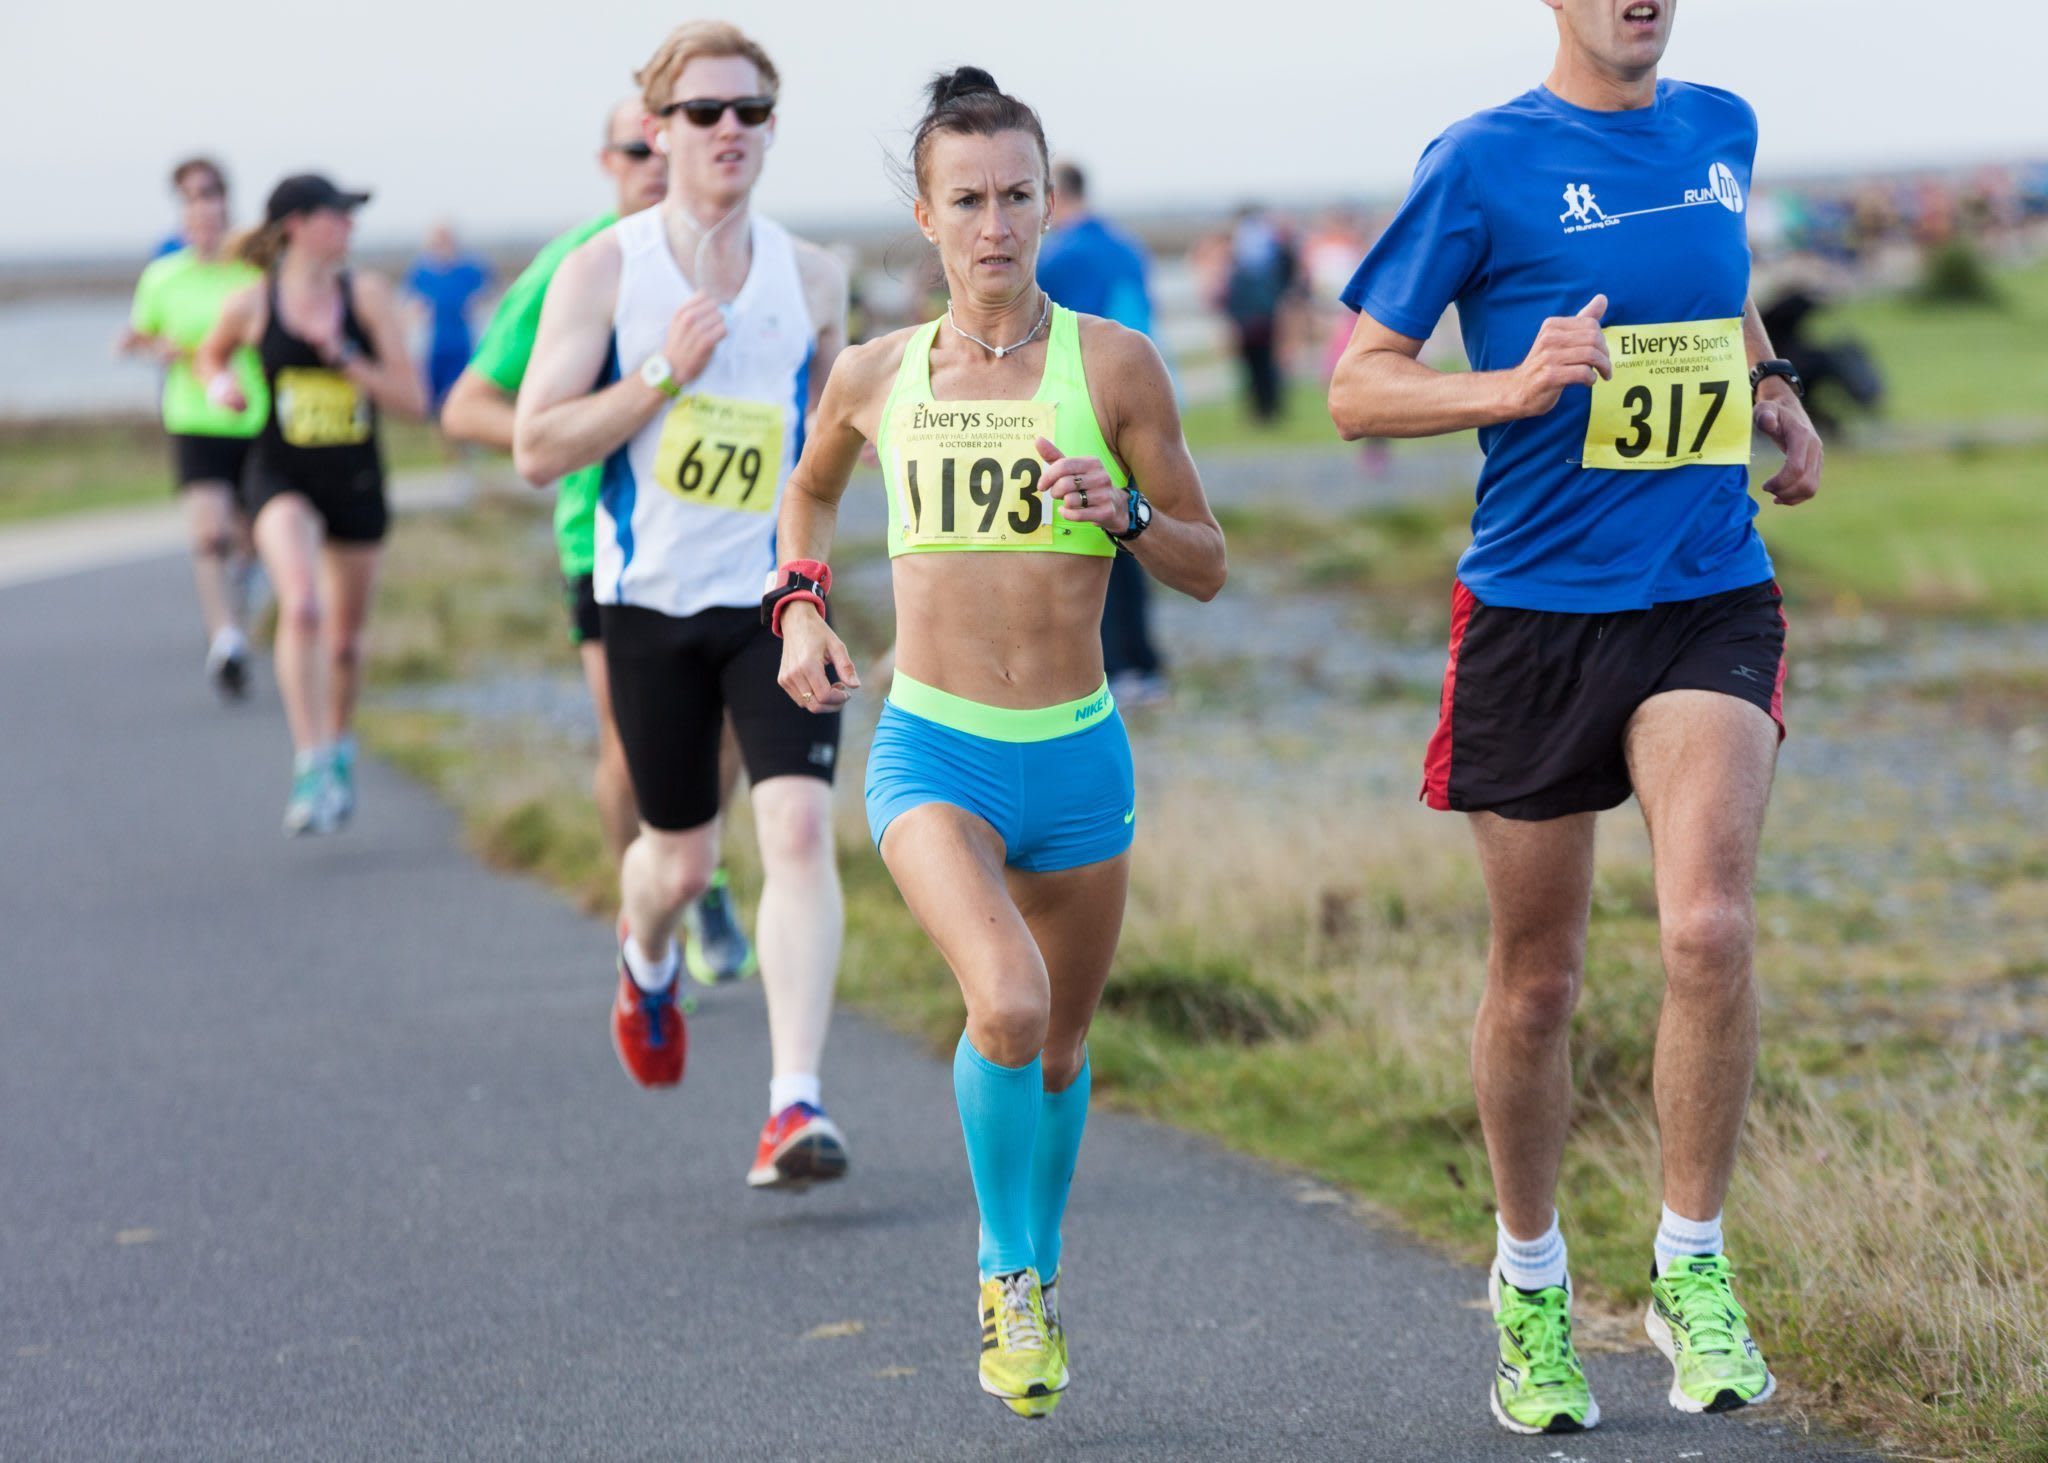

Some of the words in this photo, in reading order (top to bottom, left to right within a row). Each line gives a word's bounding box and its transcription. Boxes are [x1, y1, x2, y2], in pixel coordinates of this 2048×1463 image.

[1684, 186, 1714, 203] RUN
[1575, 221, 1605, 232] Running
[1604, 218, 1620, 226] Club
[1621, 333, 1688, 356] Elverys
[1693, 335, 1729, 352] Sports
[1615, 360, 1644, 369] GALWAY
[1645, 359, 1659, 367] BAY
[1659, 358, 1678, 366] HALF
[1679, 355, 1718, 365] MARATHON
[1654, 366, 1690, 375] OCTOBER
[1691, 364, 1709, 372] 2014
[913, 409, 981, 431] Elverys
[986, 412, 1034, 430] Sports
[1614, 379, 1730, 459] 317
[906, 434, 935, 442] GALWAY
[676, 439, 763, 503] 679
[907, 457, 1043, 535] 1193
[1076, 698, 1103, 721] NIKE
